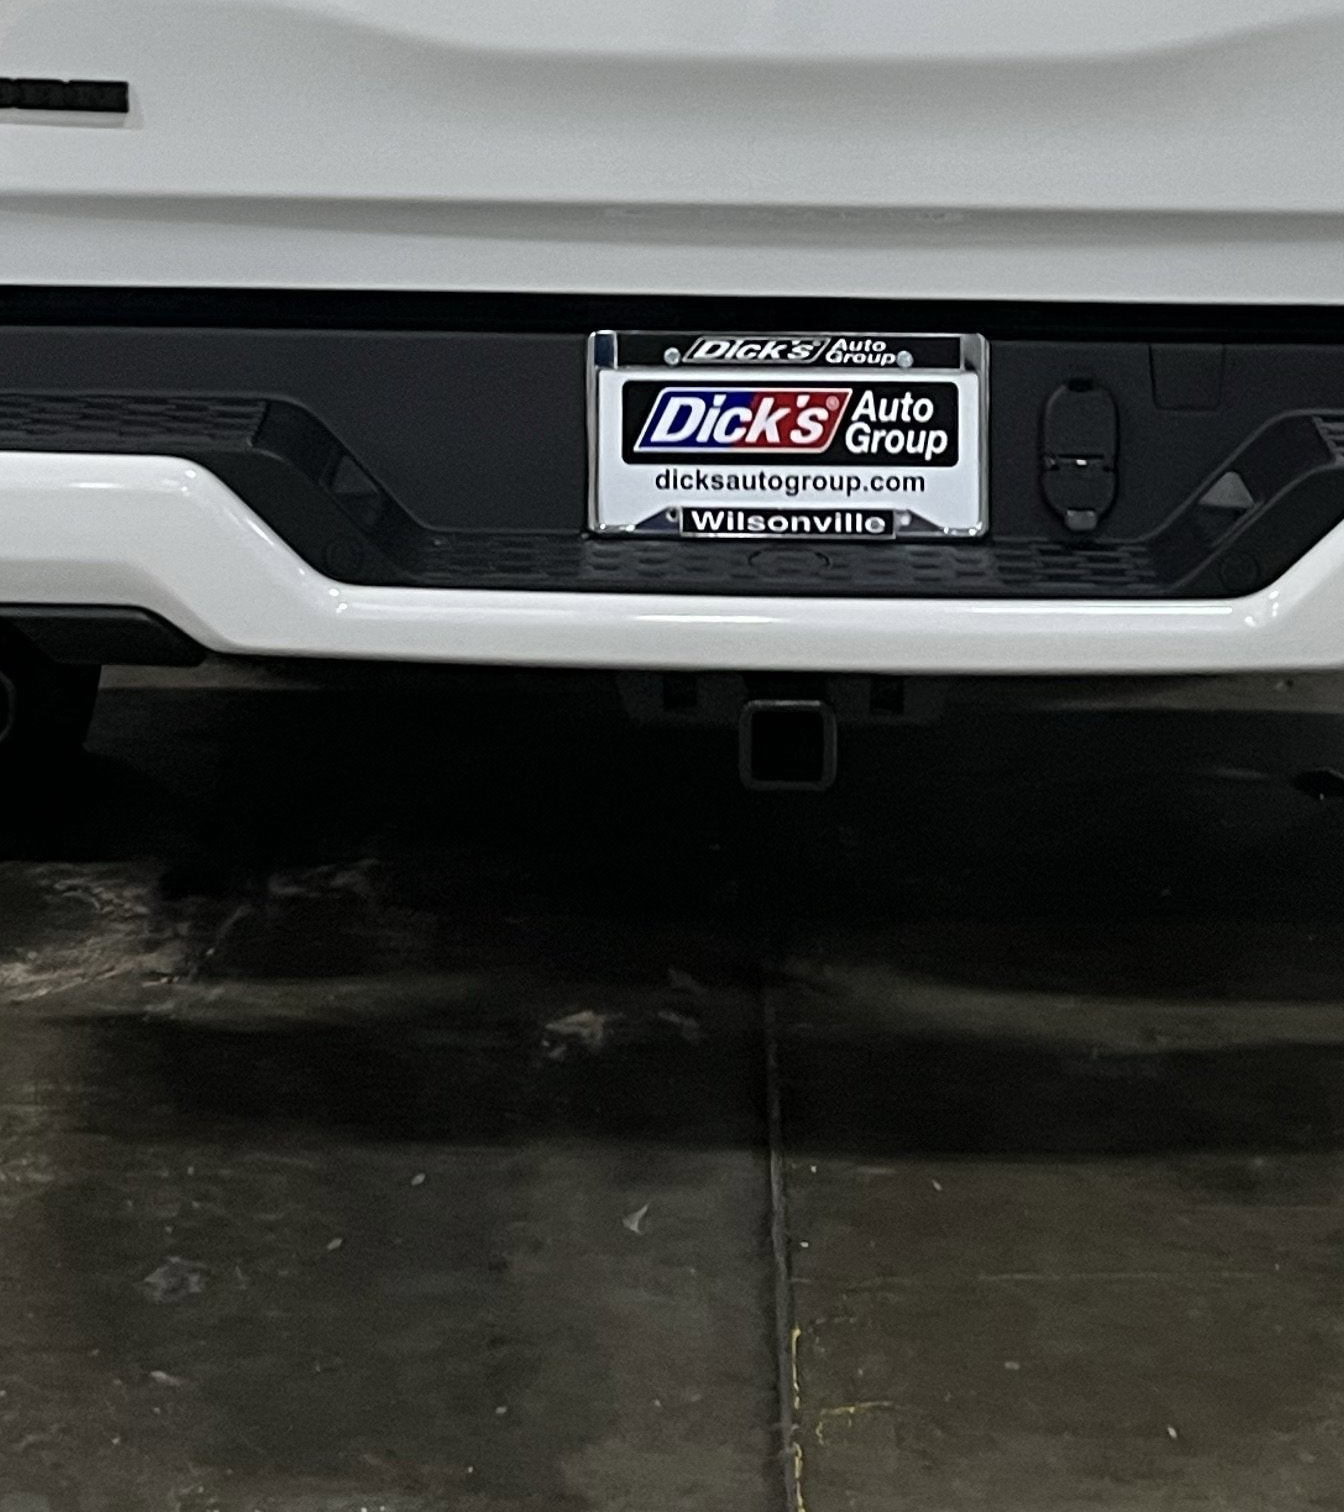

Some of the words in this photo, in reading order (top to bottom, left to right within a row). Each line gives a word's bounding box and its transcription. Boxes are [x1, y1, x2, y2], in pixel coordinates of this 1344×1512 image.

[692, 339, 816, 360] Dick's
[825, 350, 896, 367] Group
[832, 338, 887, 353] Auto
[650, 394, 830, 444] Dick's
[852, 390, 935, 423] Auto
[845, 422, 949, 460] Group
[655, 468, 926, 497] dicksautogroup.com
[690, 509, 886, 534] Wilsonville
